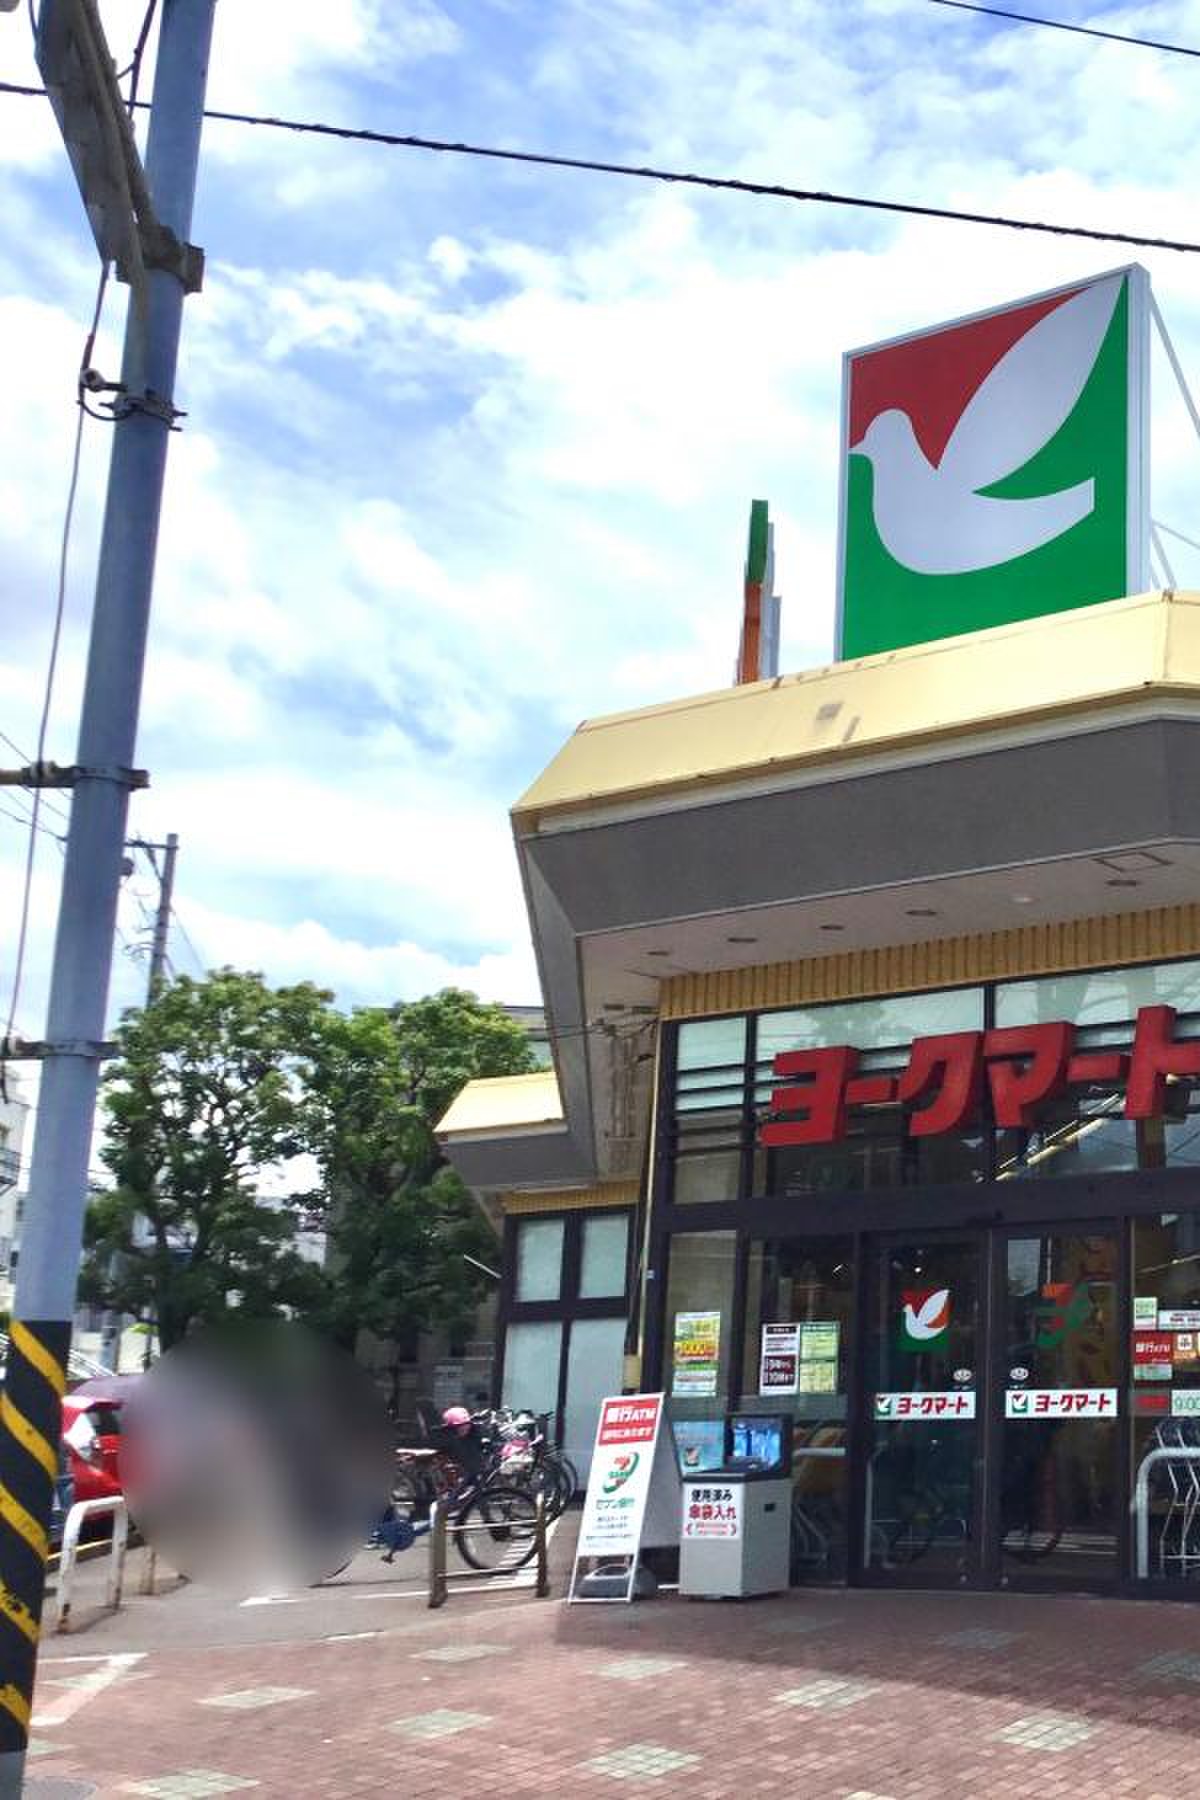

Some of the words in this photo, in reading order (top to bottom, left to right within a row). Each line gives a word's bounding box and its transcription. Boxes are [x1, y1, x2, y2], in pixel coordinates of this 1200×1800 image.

[897, 1396, 969, 1415] ヨークマート
[1035, 1393, 1111, 1413] ヨークマート
